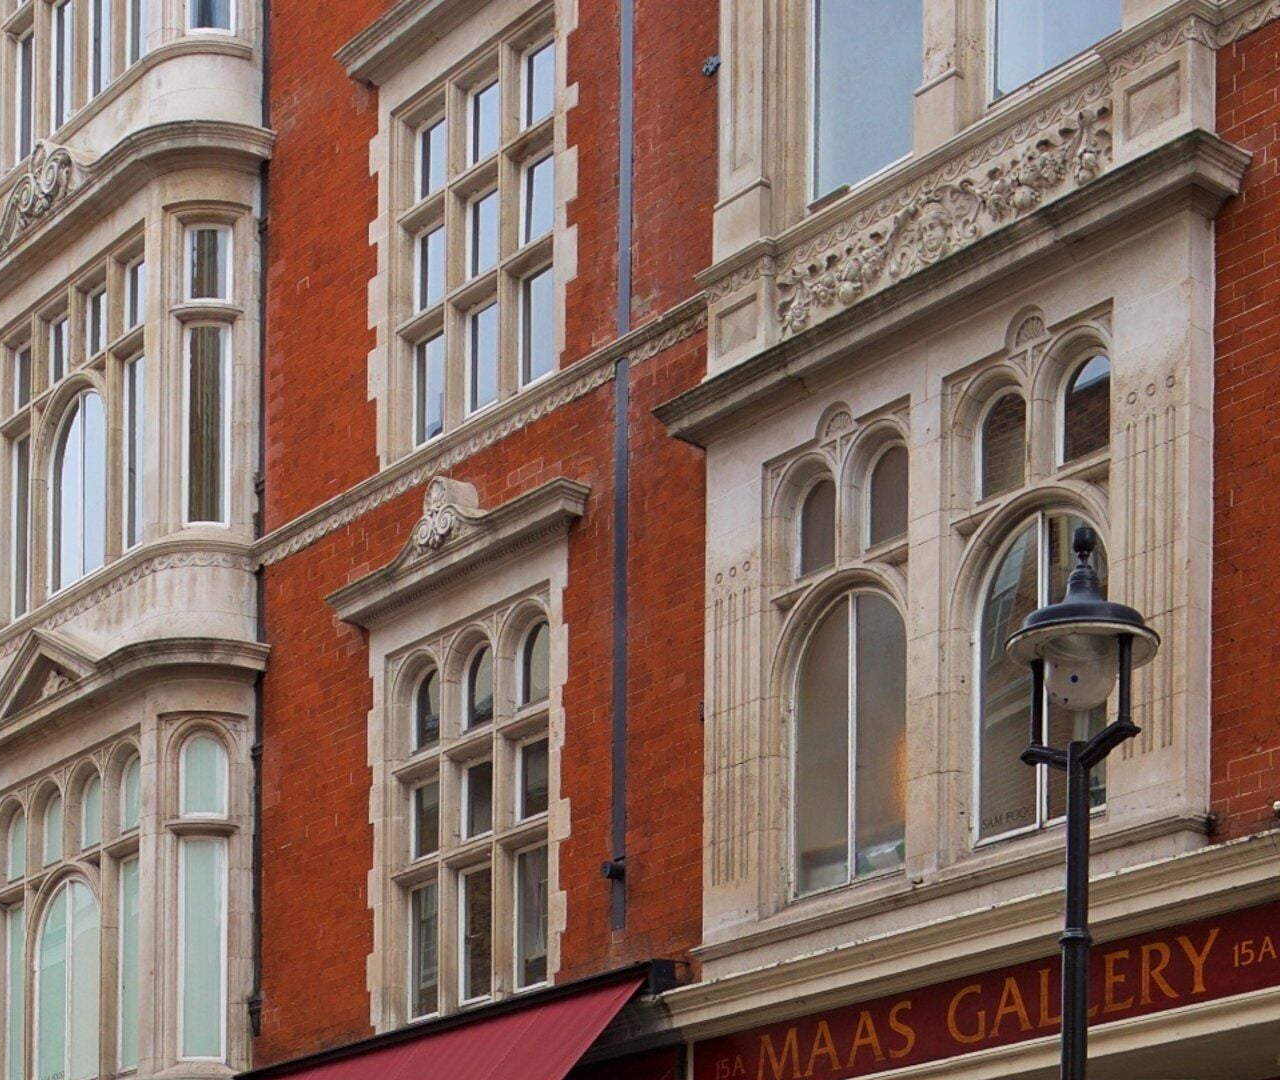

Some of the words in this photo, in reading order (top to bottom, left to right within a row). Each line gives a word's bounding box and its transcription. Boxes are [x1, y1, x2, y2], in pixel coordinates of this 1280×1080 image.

[982, 815, 1003, 829] SAM
[716, 1055, 745, 1080] 15A
[947, 928, 1220, 1044] GALERY
[1232, 935, 1278, 967] 15A
